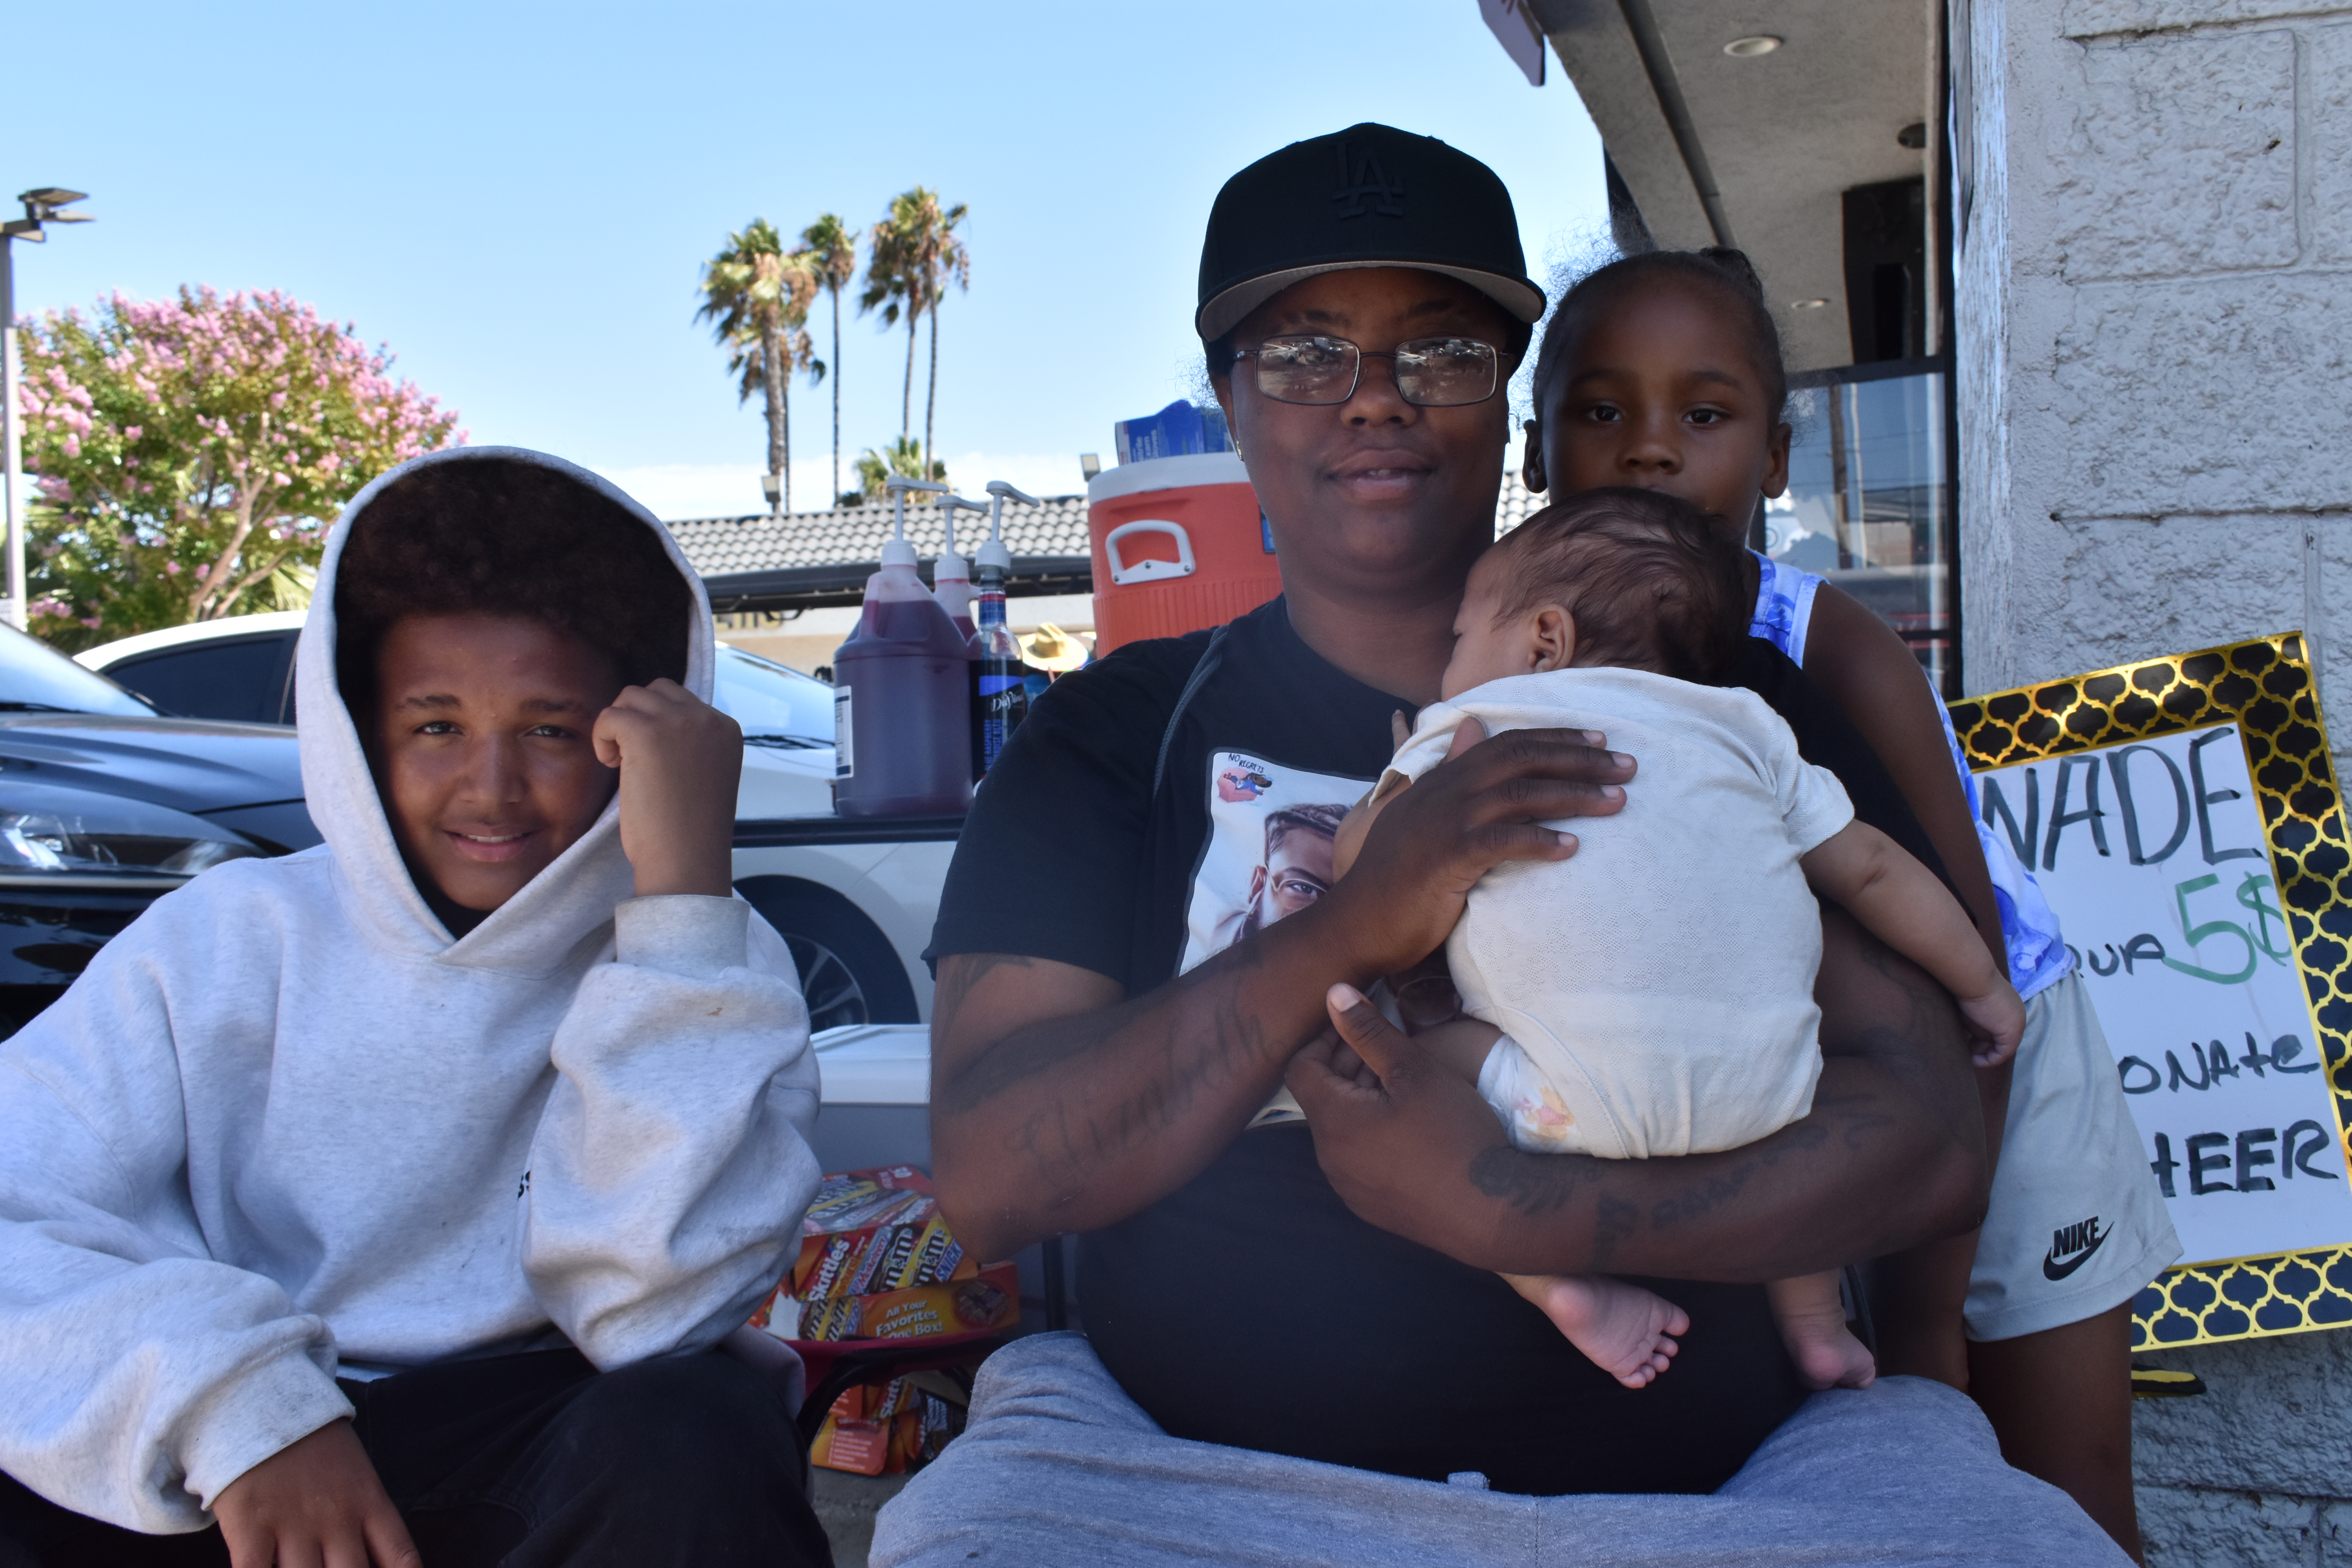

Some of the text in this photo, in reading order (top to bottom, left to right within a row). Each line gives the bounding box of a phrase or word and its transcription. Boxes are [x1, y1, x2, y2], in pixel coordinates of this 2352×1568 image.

[1331, 138, 1406, 220] LA
[1228, 753, 1241, 762] NO
[2053, 1216, 2100, 1258] NIKE
[809, 1240, 851, 1301] Skittles
[886, 1300, 927, 1319] All Your
[875, 1310, 938, 1338] Favorites
[915, 1321, 943, 1336] Box!
